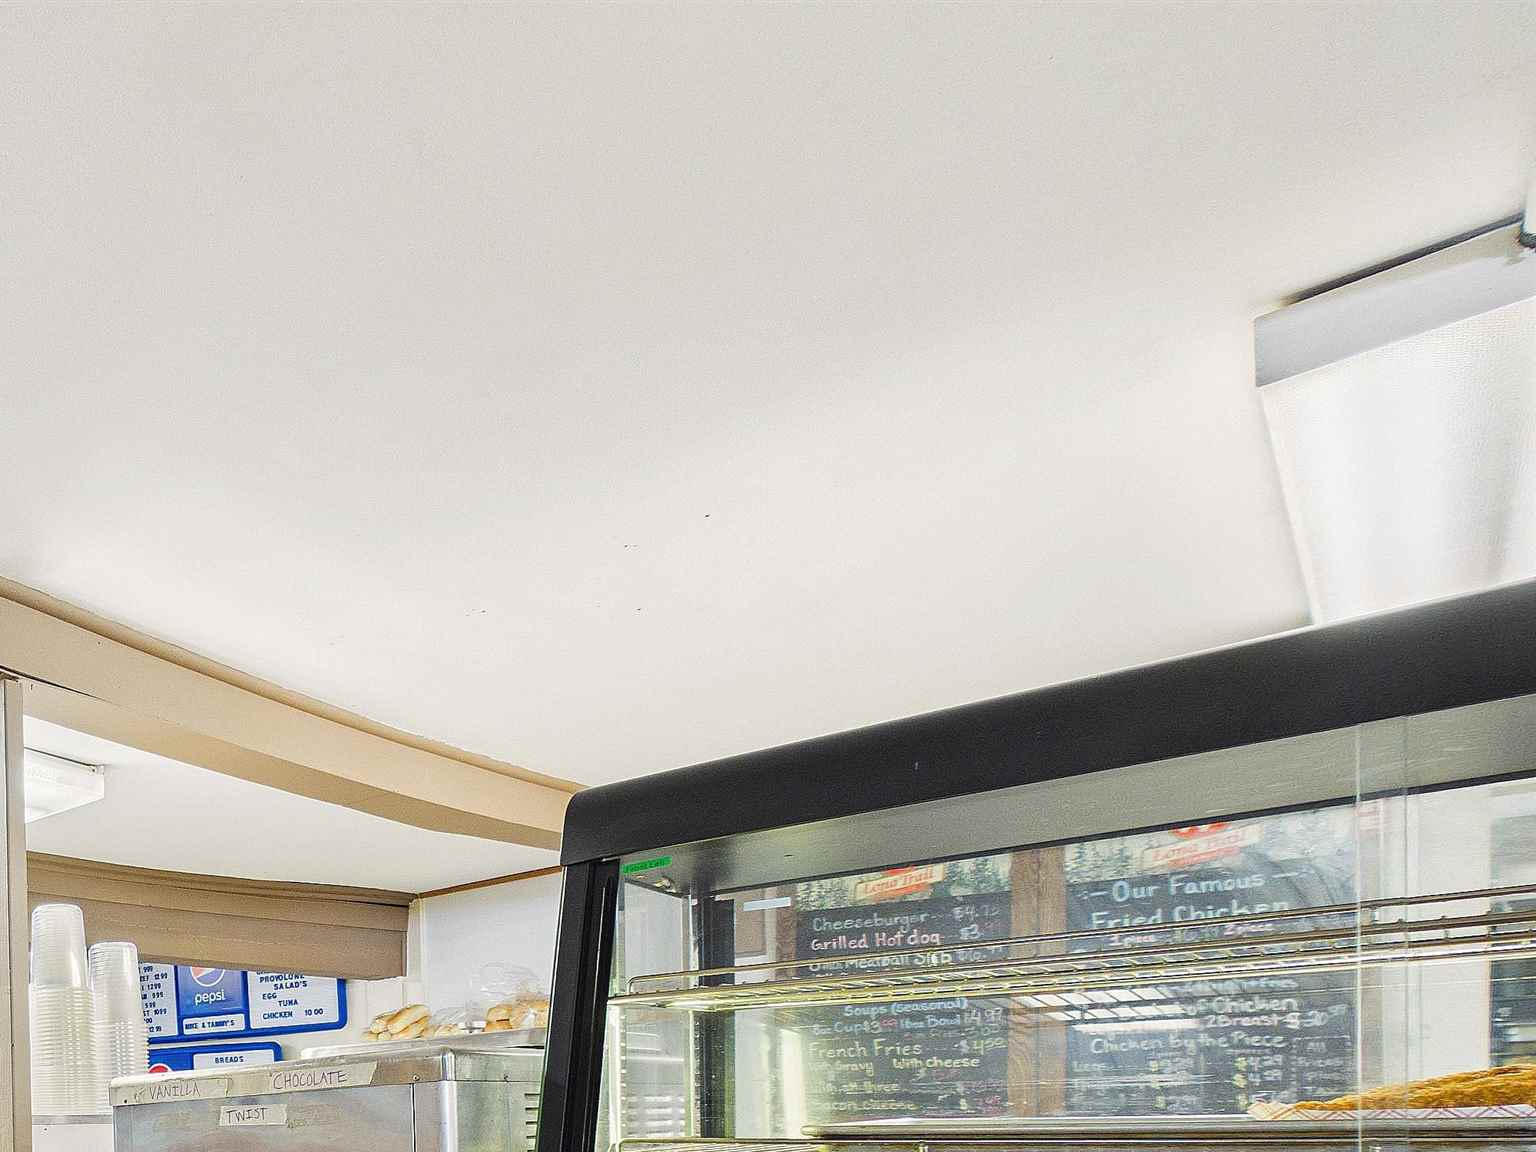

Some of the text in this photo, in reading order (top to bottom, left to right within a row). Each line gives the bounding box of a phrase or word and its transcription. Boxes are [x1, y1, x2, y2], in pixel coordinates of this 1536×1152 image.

[1112, 872, 1265, 901] Our Famous
[812, 911, 928, 933] Cheeseburger
[810, 928, 941, 951] Grilled Hot dog
[273, 980, 308, 991] SALAD'S
[194, 989, 226, 1006] pepsi
[262, 992, 278, 1001] EGG
[262, 1010, 294, 1020] CHICKEN
[872, 1038, 922, 1056] Fries
[214, 1055, 245, 1064] BREADS
[272, 1070, 348, 1090] CHOCOLATE
[149, 1083, 201, 1099] VANILLA
[226, 1106, 268, 1123] TWIST
